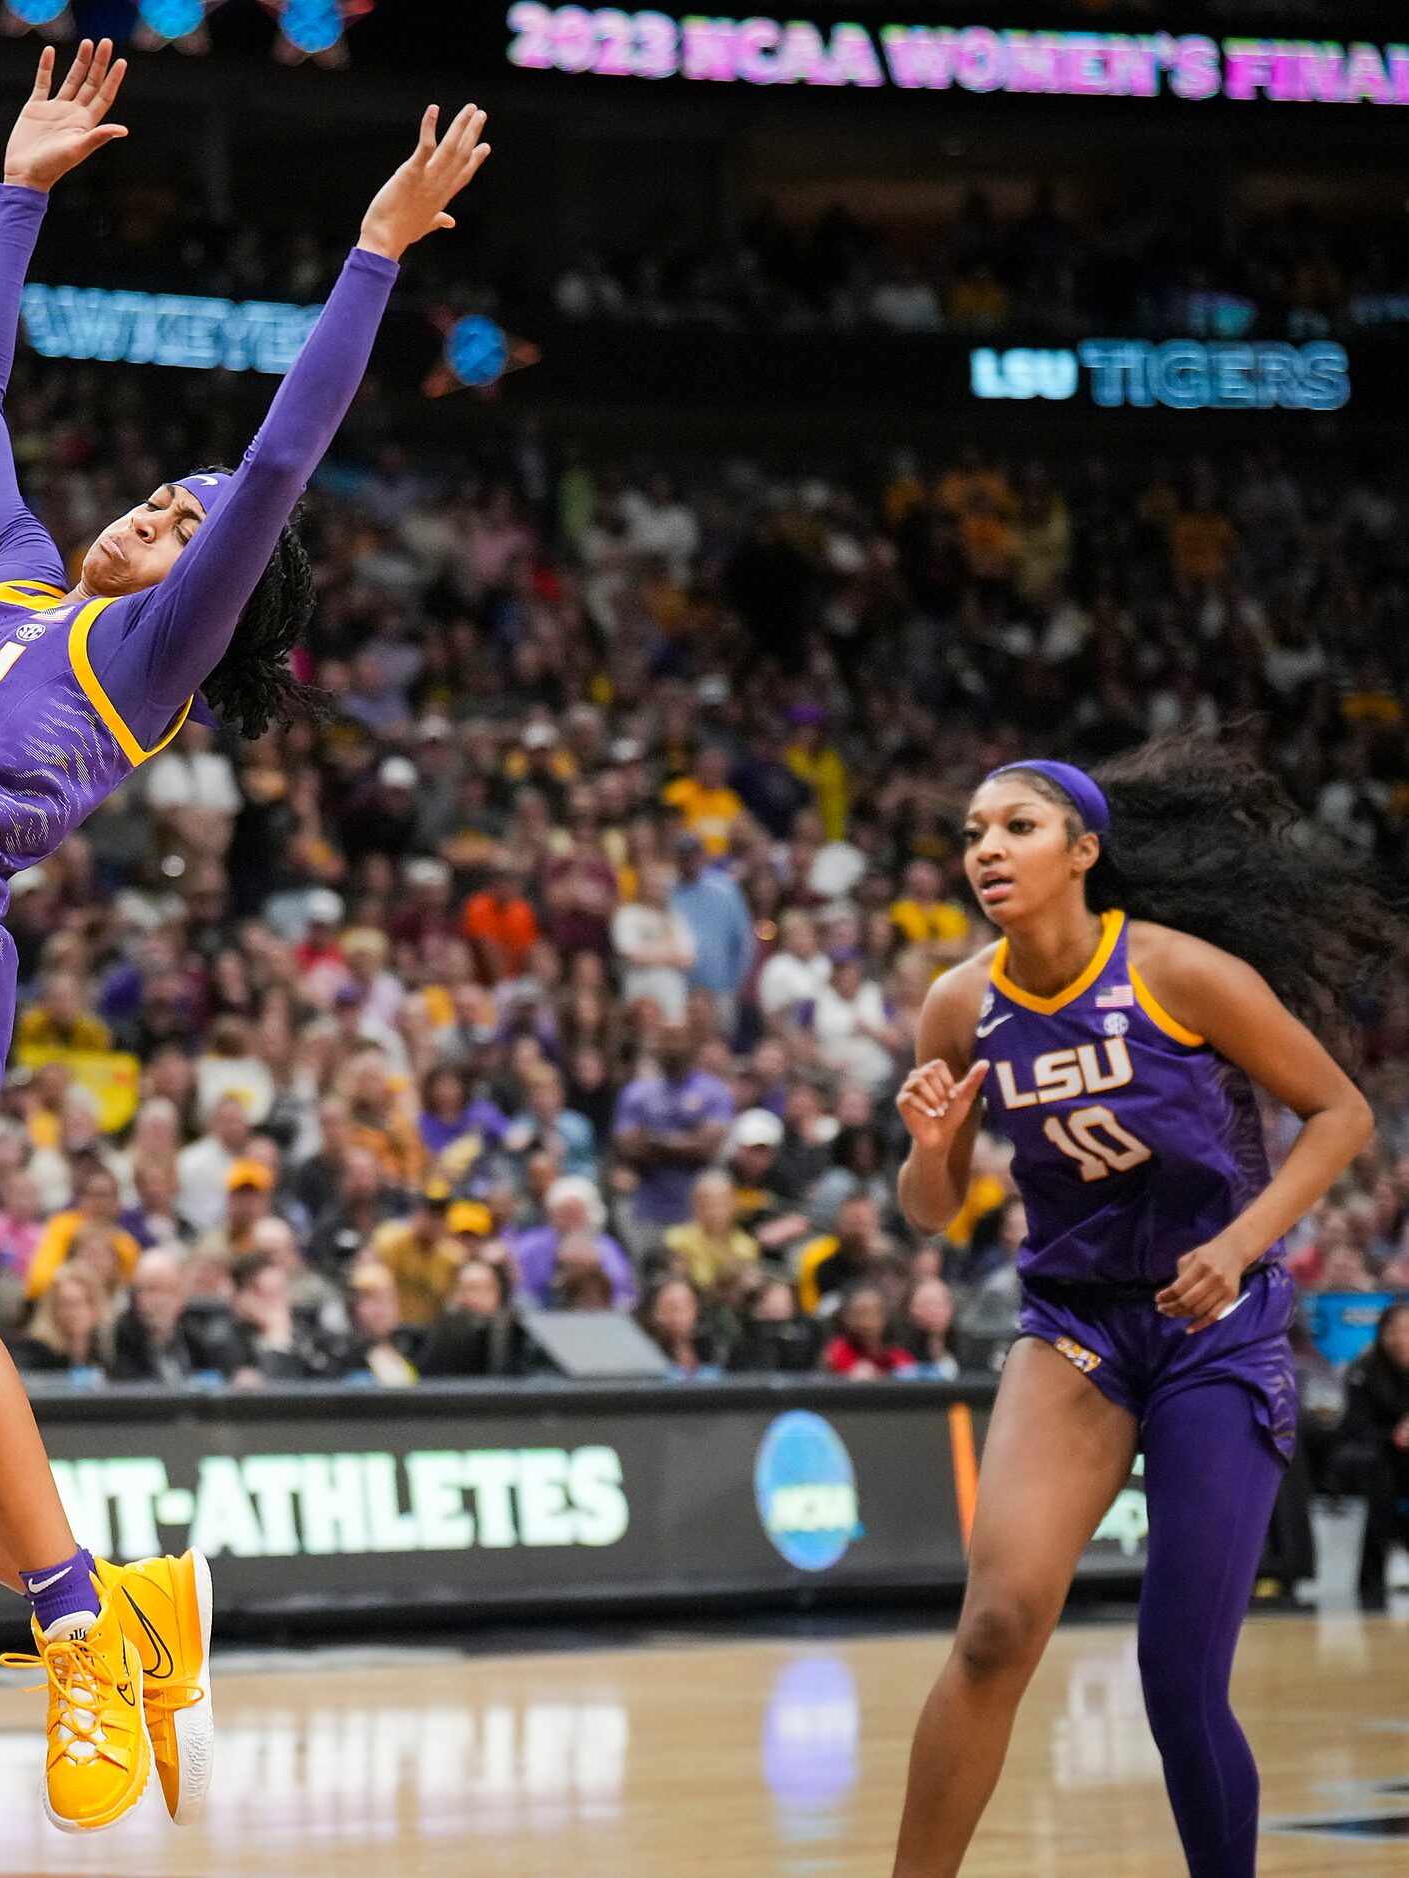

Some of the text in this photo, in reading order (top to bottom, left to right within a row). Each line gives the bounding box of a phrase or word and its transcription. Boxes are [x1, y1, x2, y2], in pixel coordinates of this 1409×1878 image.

[506, 1, 681, 79] 2023
[682, 16, 886, 87] NCAA
[881, 25, 1220, 99] WOMEN'S
[21, 282, 328, 374] AWKEYE
[970, 338, 1351, 410] LSU TIGERS
[995, 1035, 1134, 1110] LSU
[1043, 1104, 1152, 1183] 10
